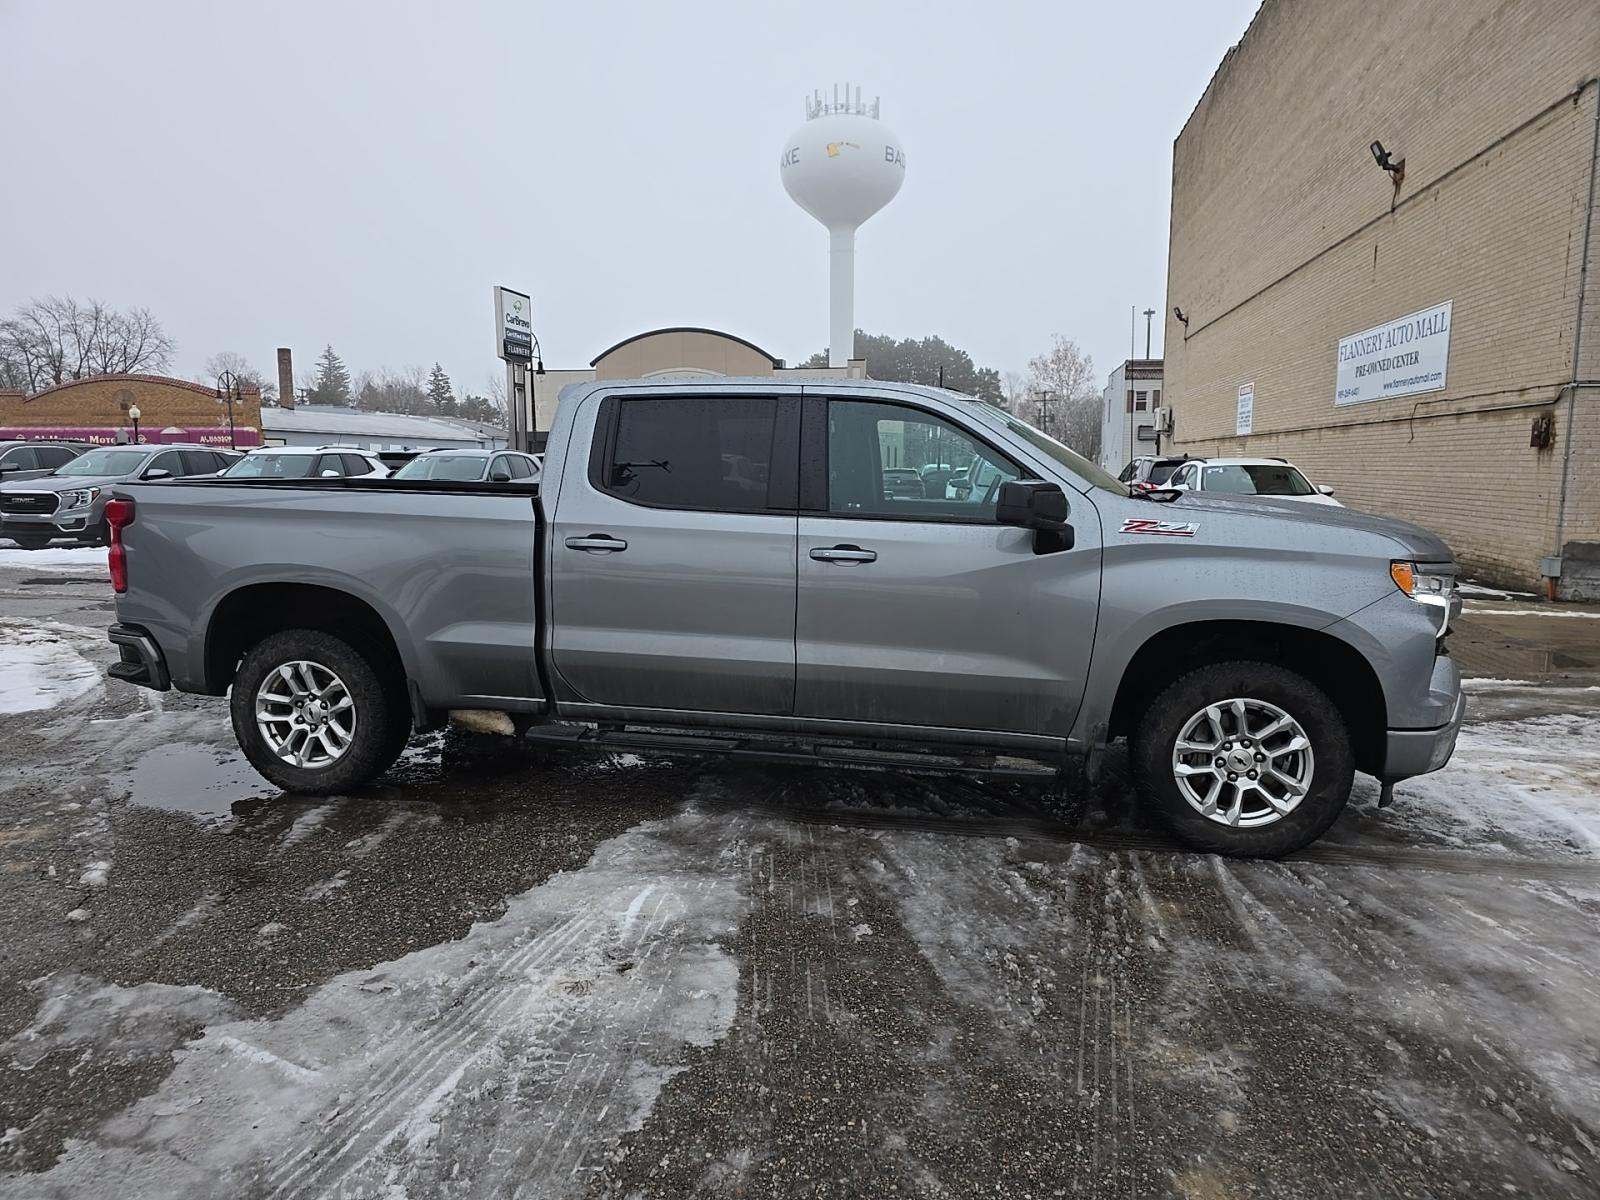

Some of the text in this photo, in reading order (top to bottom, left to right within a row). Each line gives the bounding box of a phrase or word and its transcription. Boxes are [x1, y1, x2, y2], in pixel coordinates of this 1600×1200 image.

[1339, 311, 1448, 362] FLANNERY AUTO MALL
[1355, 351, 1420, 378] PRE-OWNED CENTER
[1119, 518, 1201, 537] Z71
